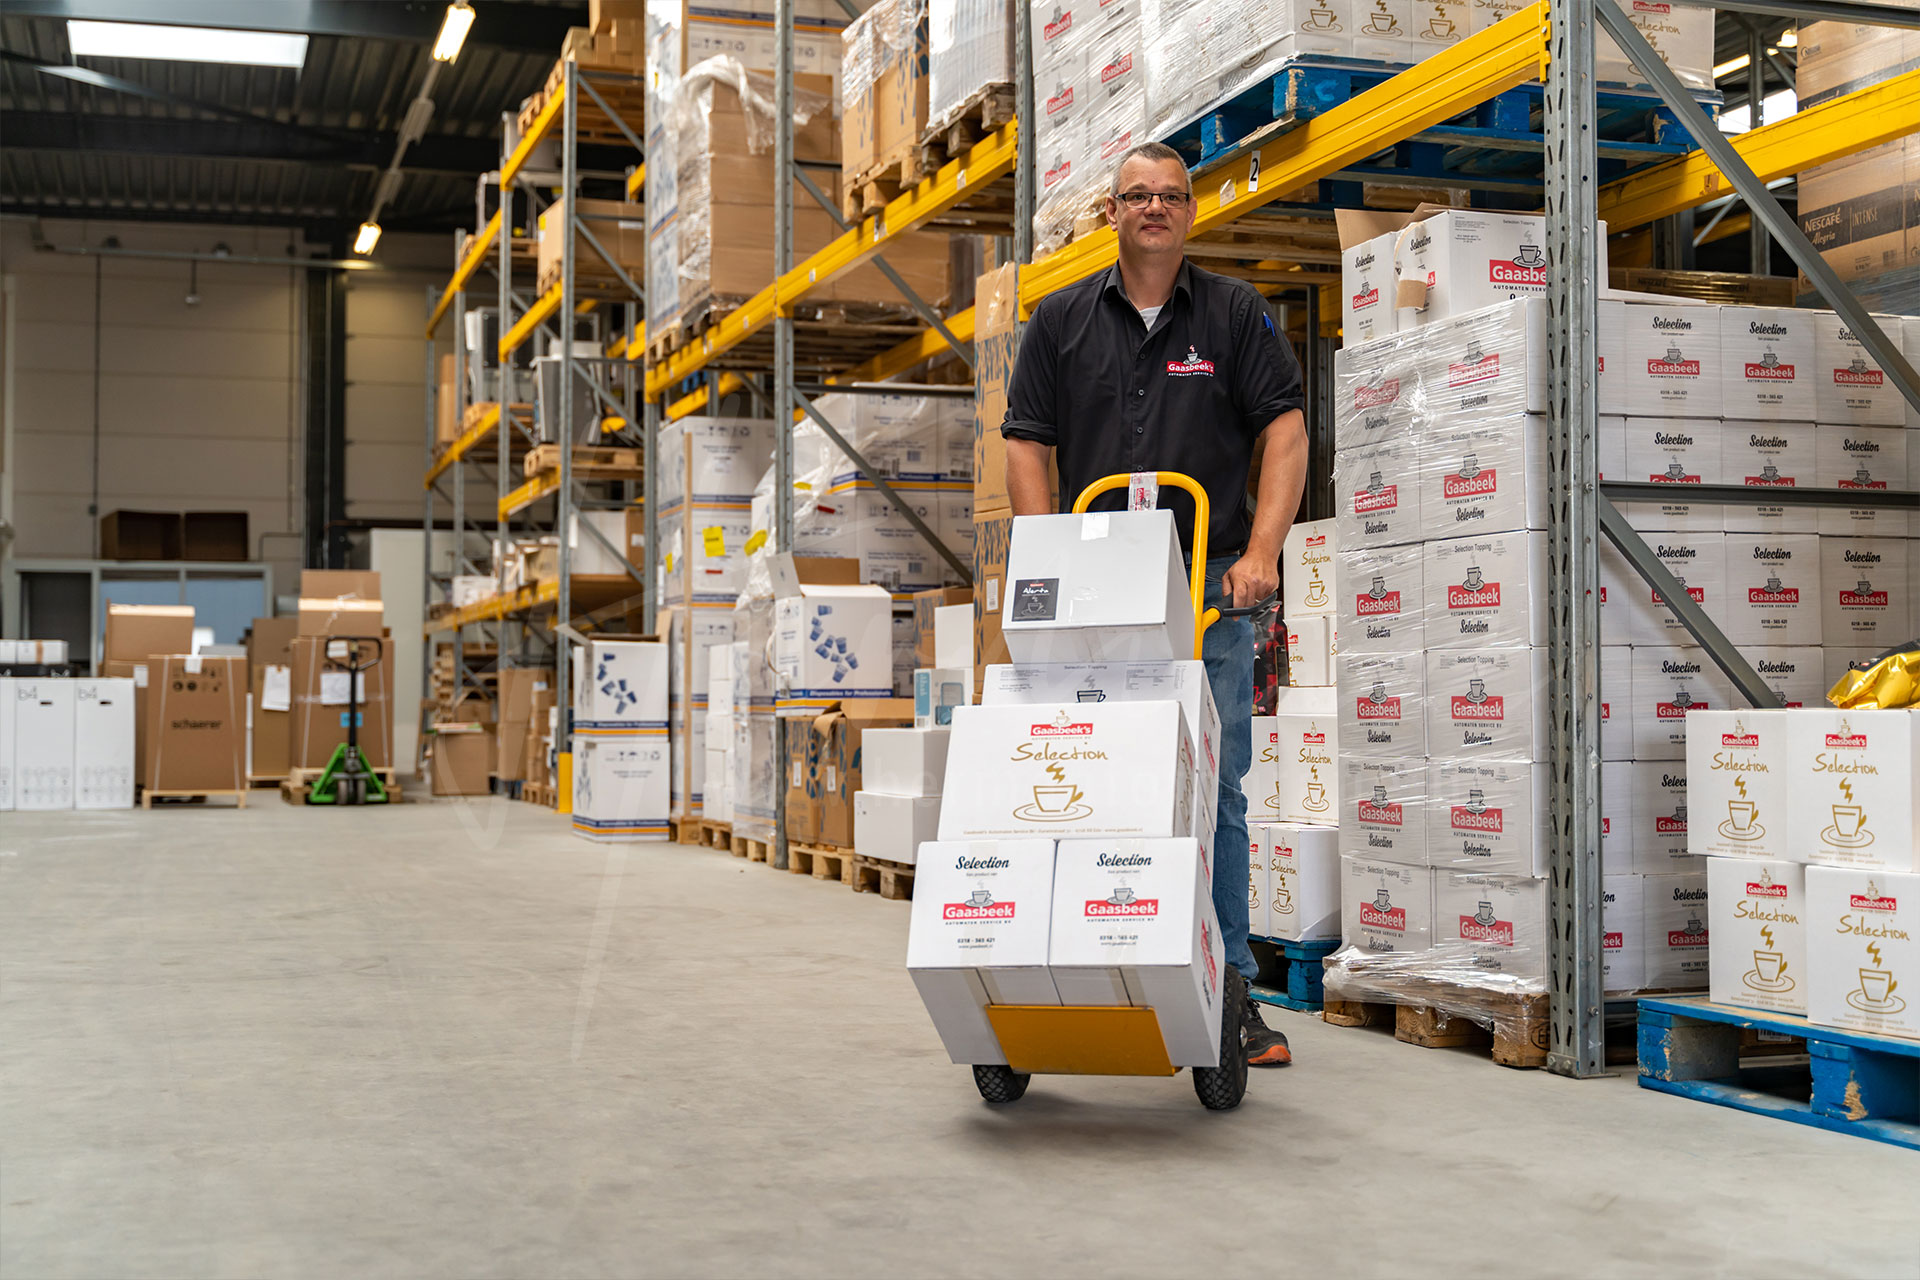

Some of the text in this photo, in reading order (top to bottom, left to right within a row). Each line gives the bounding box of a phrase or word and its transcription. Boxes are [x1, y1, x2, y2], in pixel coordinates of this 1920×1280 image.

[1634, 2, 1670, 13] Gaasbeek's
[1045, 14, 1071, 39] Gaasbeek
[1628, 15, 1680, 35] Selection
[1102, 56, 1132, 81] Gaasbeek
[1048, 90, 1073, 113] Gaasbeek
[1250, 158, 1258, 181] 2
[1805, 207, 1841, 233] NESCAFÉ
[1852, 207, 1878, 227] INTENSE
[1410, 235, 1431, 251] Selection
[1355, 254, 1375, 269] Selection
[1493, 266, 1546, 282] Gaasbe
[1353, 289, 1378, 308] Gaasbeek
[1652, 316, 1692, 330] Selection
[1749, 322, 1787, 335] Selection
[1650, 363, 1698, 374] Gaasbeek
[1747, 367, 1793, 378] Gaasbeek
[1835, 372, 1881, 383] Gaasbeek
[1654, 432, 1693, 445] Selection
[1750, 435, 1788, 448] Selection
[1843, 439, 1880, 452] Selection
[1446, 475, 1495, 496] Gaasbeek
[1356, 490, 1396, 511] Gaasbeek
[1456, 507, 1485, 521] Selection
[1365, 522, 1388, 535] Selection
[1455, 543, 1492, 552] Selection Topping
[1656, 545, 1696, 558] Selection
[1753, 547, 1791, 560] Selection
[1301, 551, 1331, 565] Selection
[1844, 550, 1881, 562] Selection
[1450, 587, 1499, 605] Gaasbeek
[1750, 592, 1797, 601] Gaasbeek
[1841, 594, 1886, 604] Gaasbeek
[1358, 597, 1399, 613] Gaasbeek
[1460, 619, 1489, 634] Selection
[1457, 655, 1495, 664] Selection Topping
[1662, 660, 1701, 673] Selection
[1758, 660, 1795, 673] Selection
[1359, 703, 1400, 719] Gaasbeek
[1453, 702, 1502, 719] Gaasbeek
[171, 720, 222, 730] schaerer
[1032, 725, 1091, 735] Gaasbeek's
[1367, 730, 1392, 743] Selection
[1464, 731, 1492, 745] Selection
[1723, 736, 1758, 746] Gaasbeek's
[1826, 735, 1866, 747] Gaasbeek's
[1011, 742, 1108, 761] Selection
[1298, 748, 1332, 764] Selection
[1380, 764, 1395, 773] Topping
[1711, 752, 1769, 773] Selection
[1812, 753, 1879, 775] Selection
[1477, 768, 1494, 777] Topping
[1360, 806, 1401, 822] Gaasbeek
[1453, 812, 1501, 829] Gaasbeek
[1368, 833, 1393, 848] Selection
[1463, 841, 1492, 857] Selection
[956, 856, 1009, 870] Selection
[1097, 853, 1152, 867] Selection
[1270, 858, 1297, 876] Selection
[1367, 866, 1400, 878] Selection Topping
[1747, 885, 1786, 897] Gaasbeek's
[1087, 902, 1156, 915] Gaasbeek
[1851, 897, 1896, 910] Gaasbeek's
[946, 905, 1013, 918] Gaasbeek
[1361, 909, 1404, 928] Gaasbeek
[1733, 900, 1799, 925] Selection
[1462, 922, 1513, 943] Gaasbeek
[1836, 915, 1910, 941] Selection
[1369, 937, 1394, 952] Selection
[1670, 934, 1708, 944] Gaasbe
